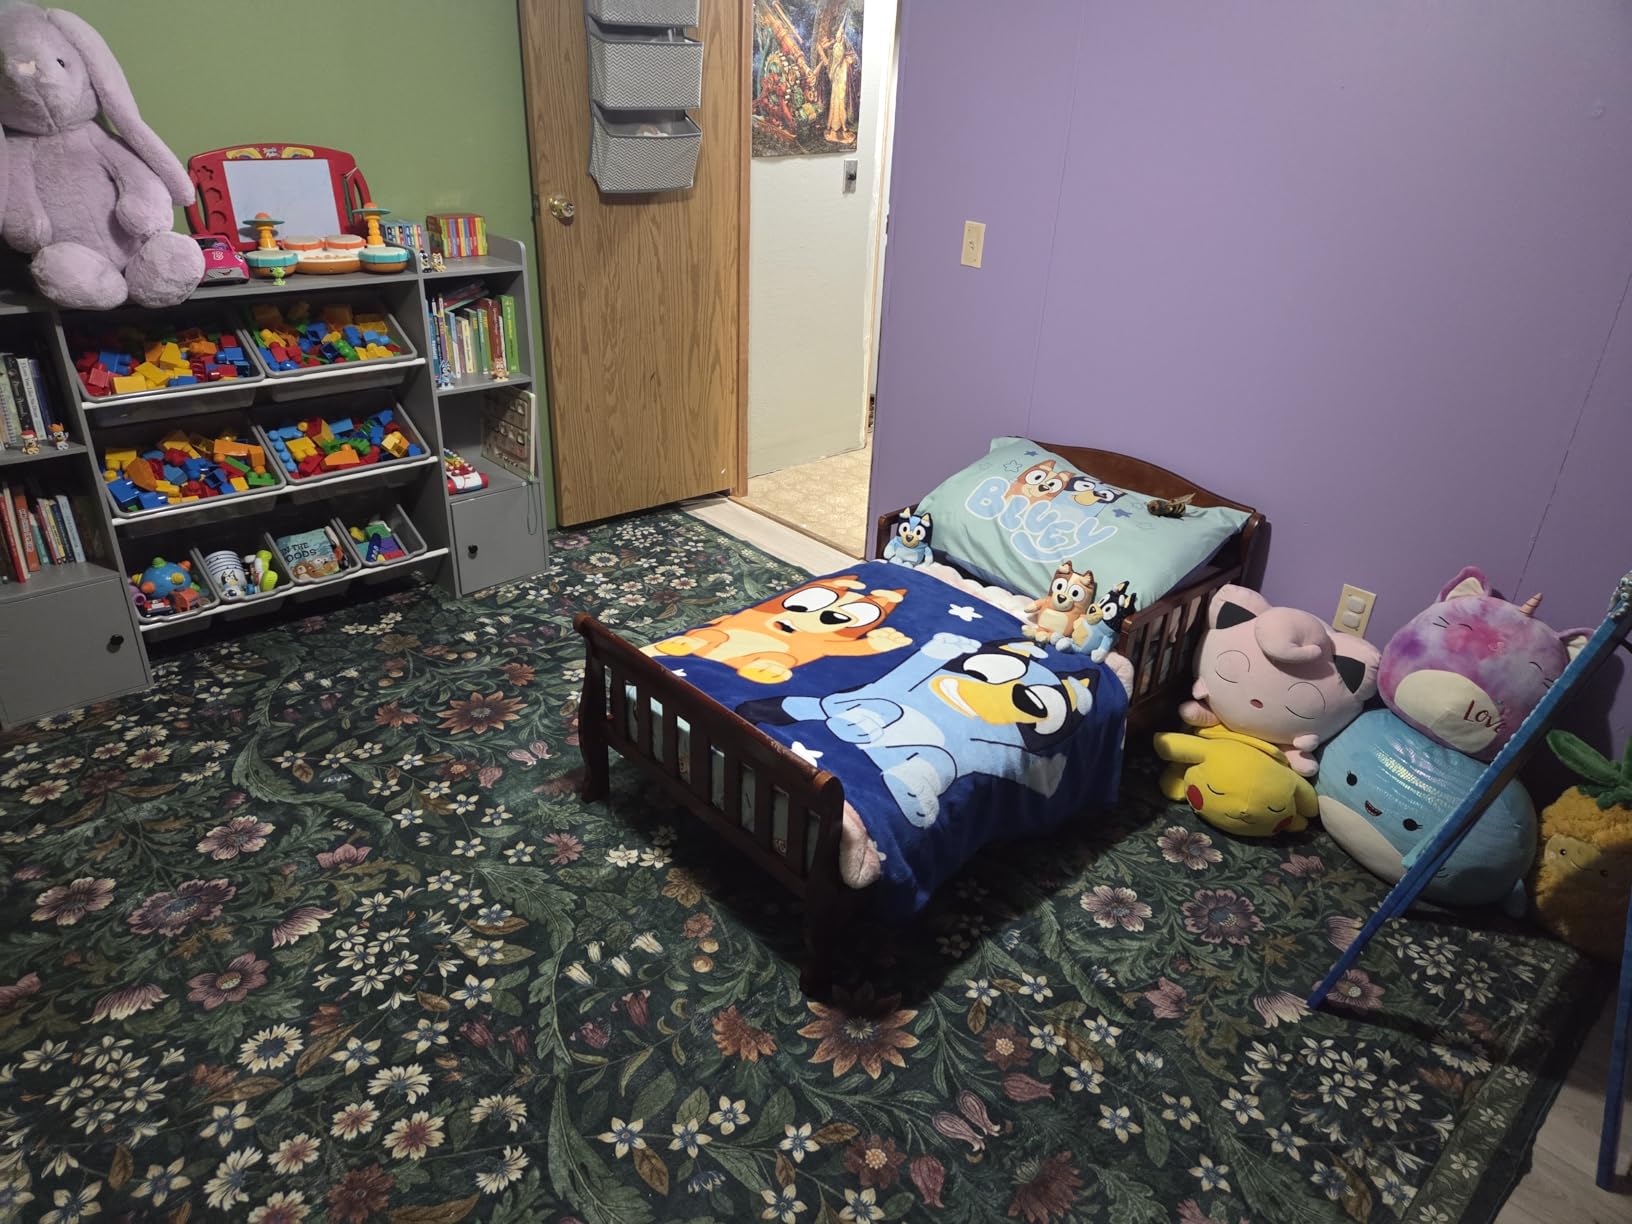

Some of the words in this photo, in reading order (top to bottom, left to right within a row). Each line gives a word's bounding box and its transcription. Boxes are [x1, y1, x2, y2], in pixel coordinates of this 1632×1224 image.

[965, 476, 1118, 563] BLUEY
[292, 542, 310, 550] THE
[284, 549, 317, 562] OODS
